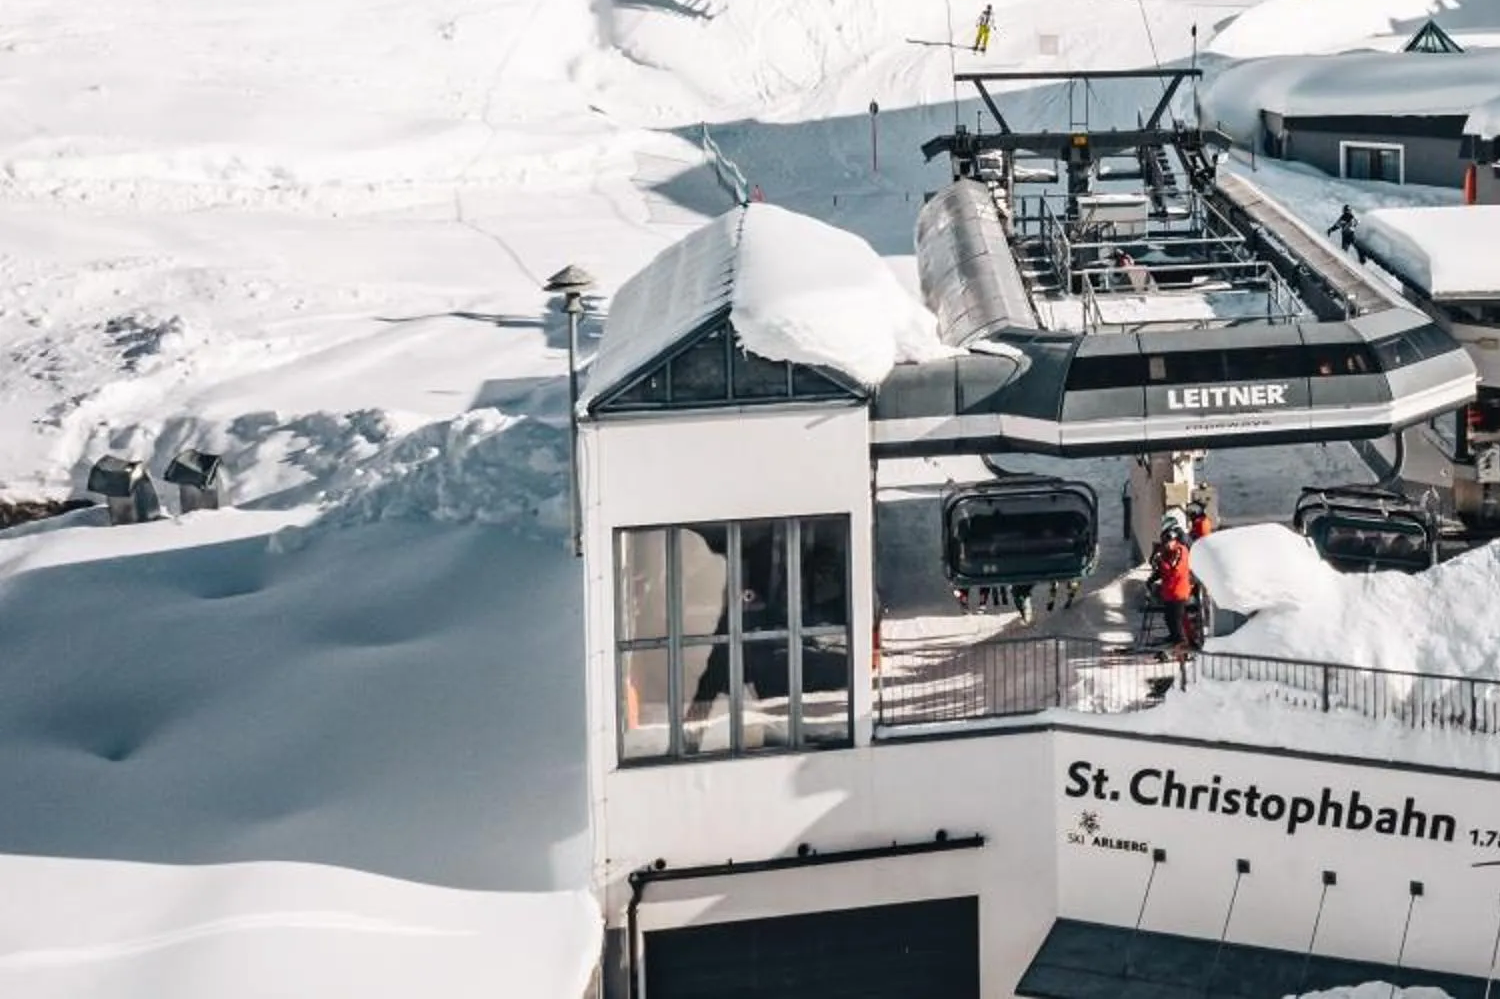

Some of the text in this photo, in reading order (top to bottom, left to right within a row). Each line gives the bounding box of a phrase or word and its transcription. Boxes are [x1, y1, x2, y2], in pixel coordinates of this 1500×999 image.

[1167, 384, 1287, 409] LEITNER
[1065, 760, 1457, 842] St. Christophbahn
[1067, 832, 1149, 853] SKI ARLBERG
